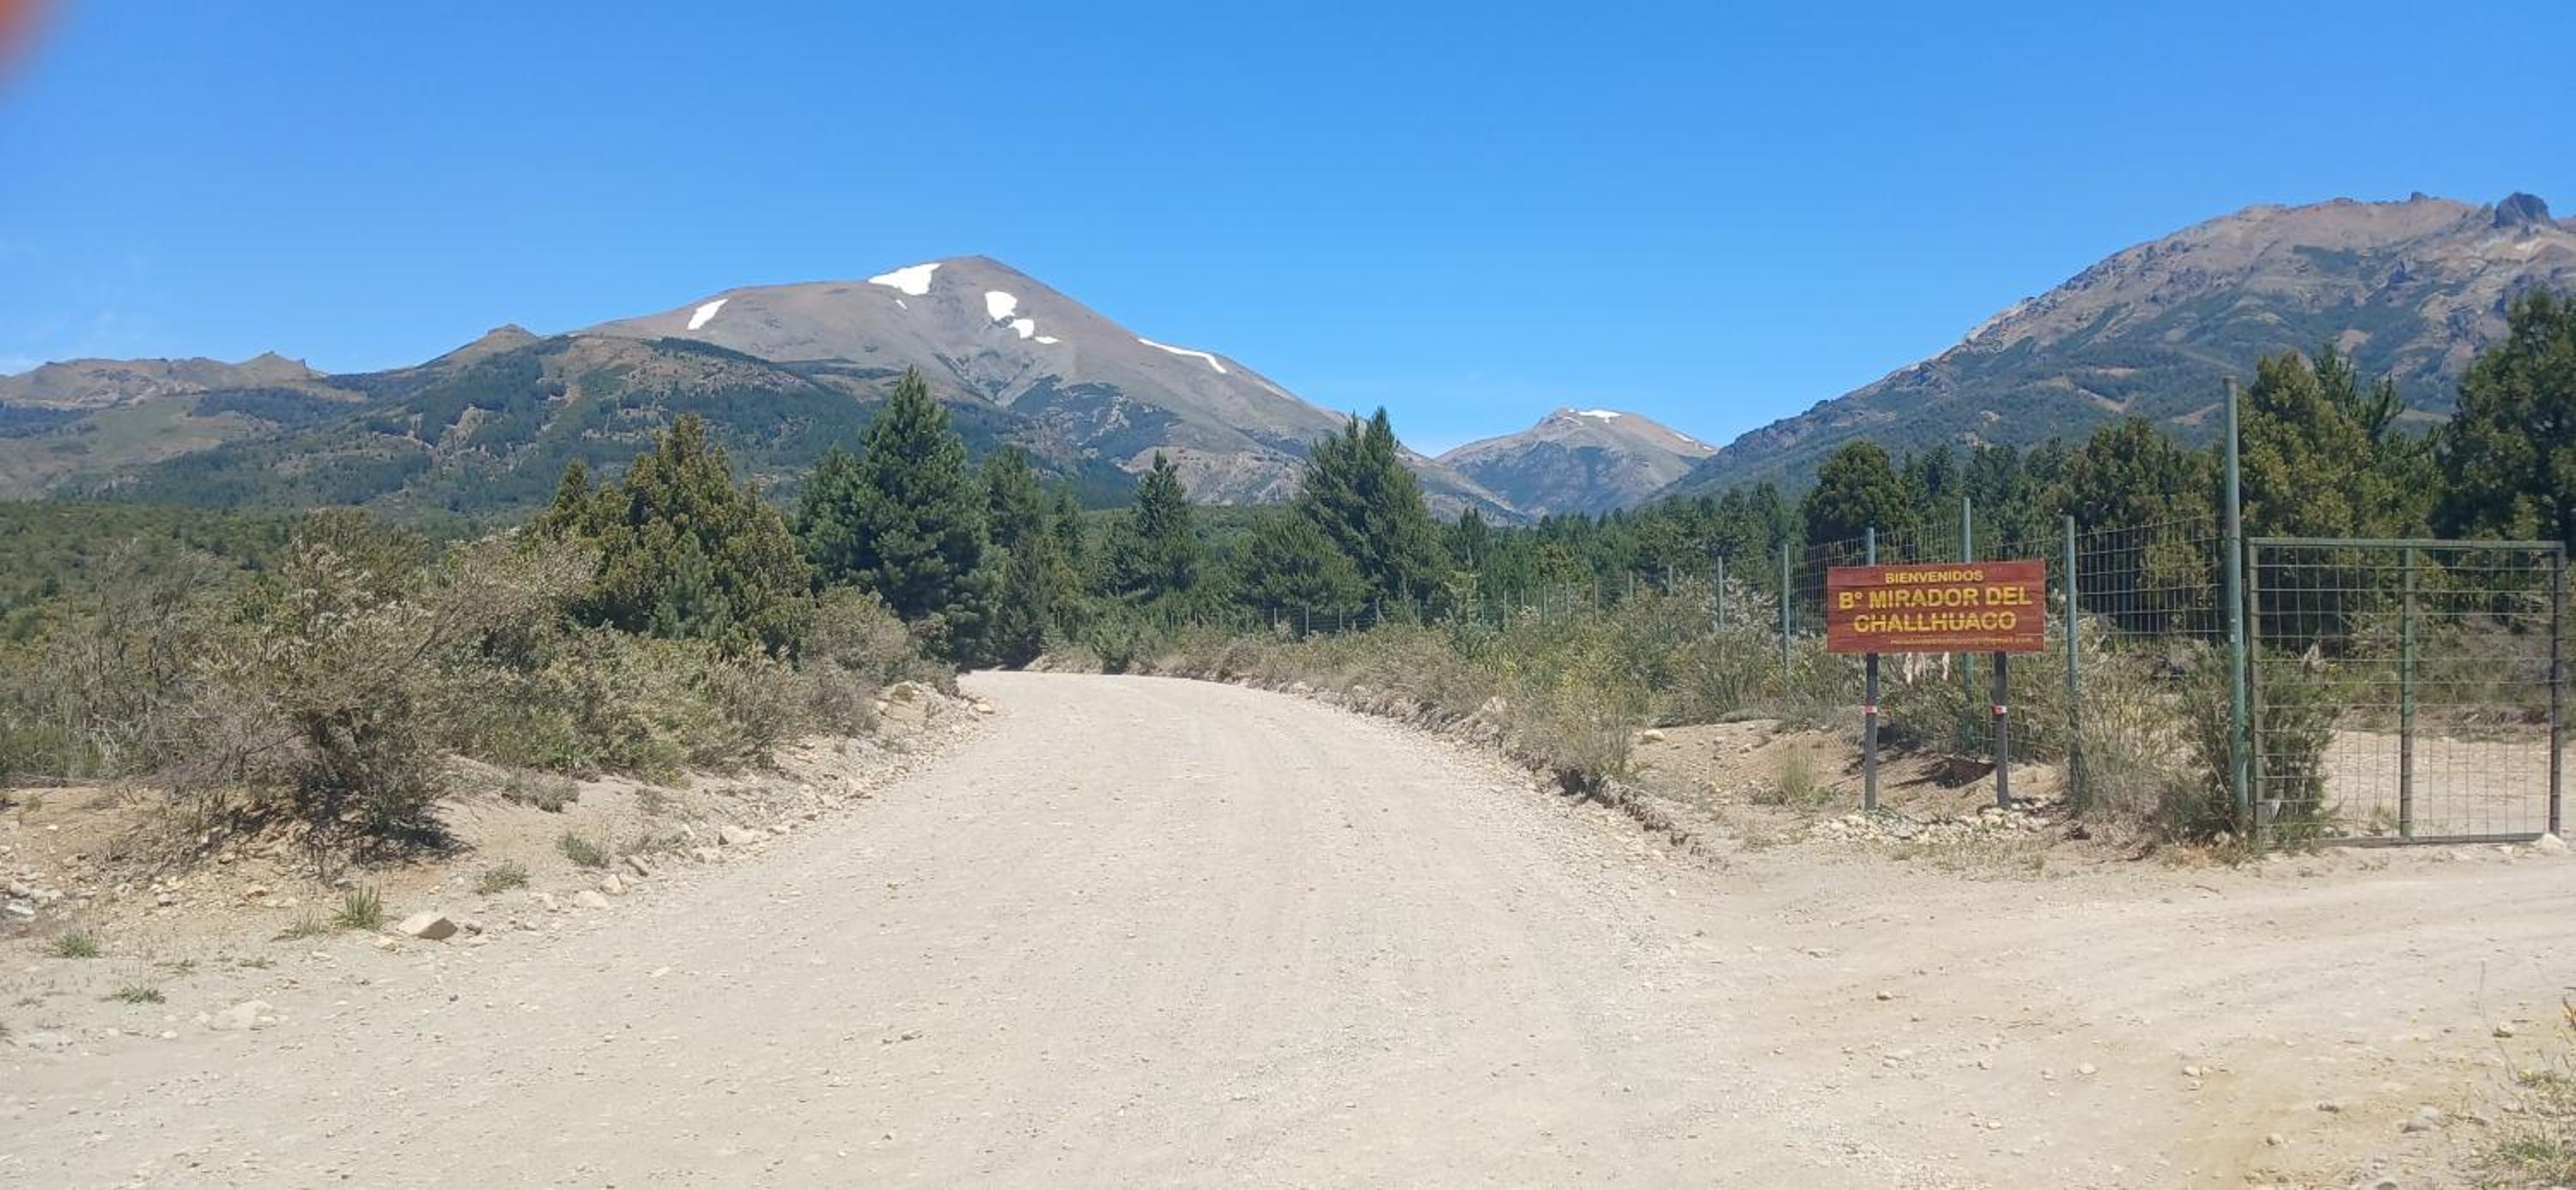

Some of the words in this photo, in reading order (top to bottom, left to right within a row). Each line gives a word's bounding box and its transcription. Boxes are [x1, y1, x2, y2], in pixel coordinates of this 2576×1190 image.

[1885, 570, 1984, 584] BIENVENIDOS
[1868, 588, 1978, 609] MIRADOR
[1984, 586, 2033, 605] DEL
[1854, 611, 2017, 633] CHALLHUACO
